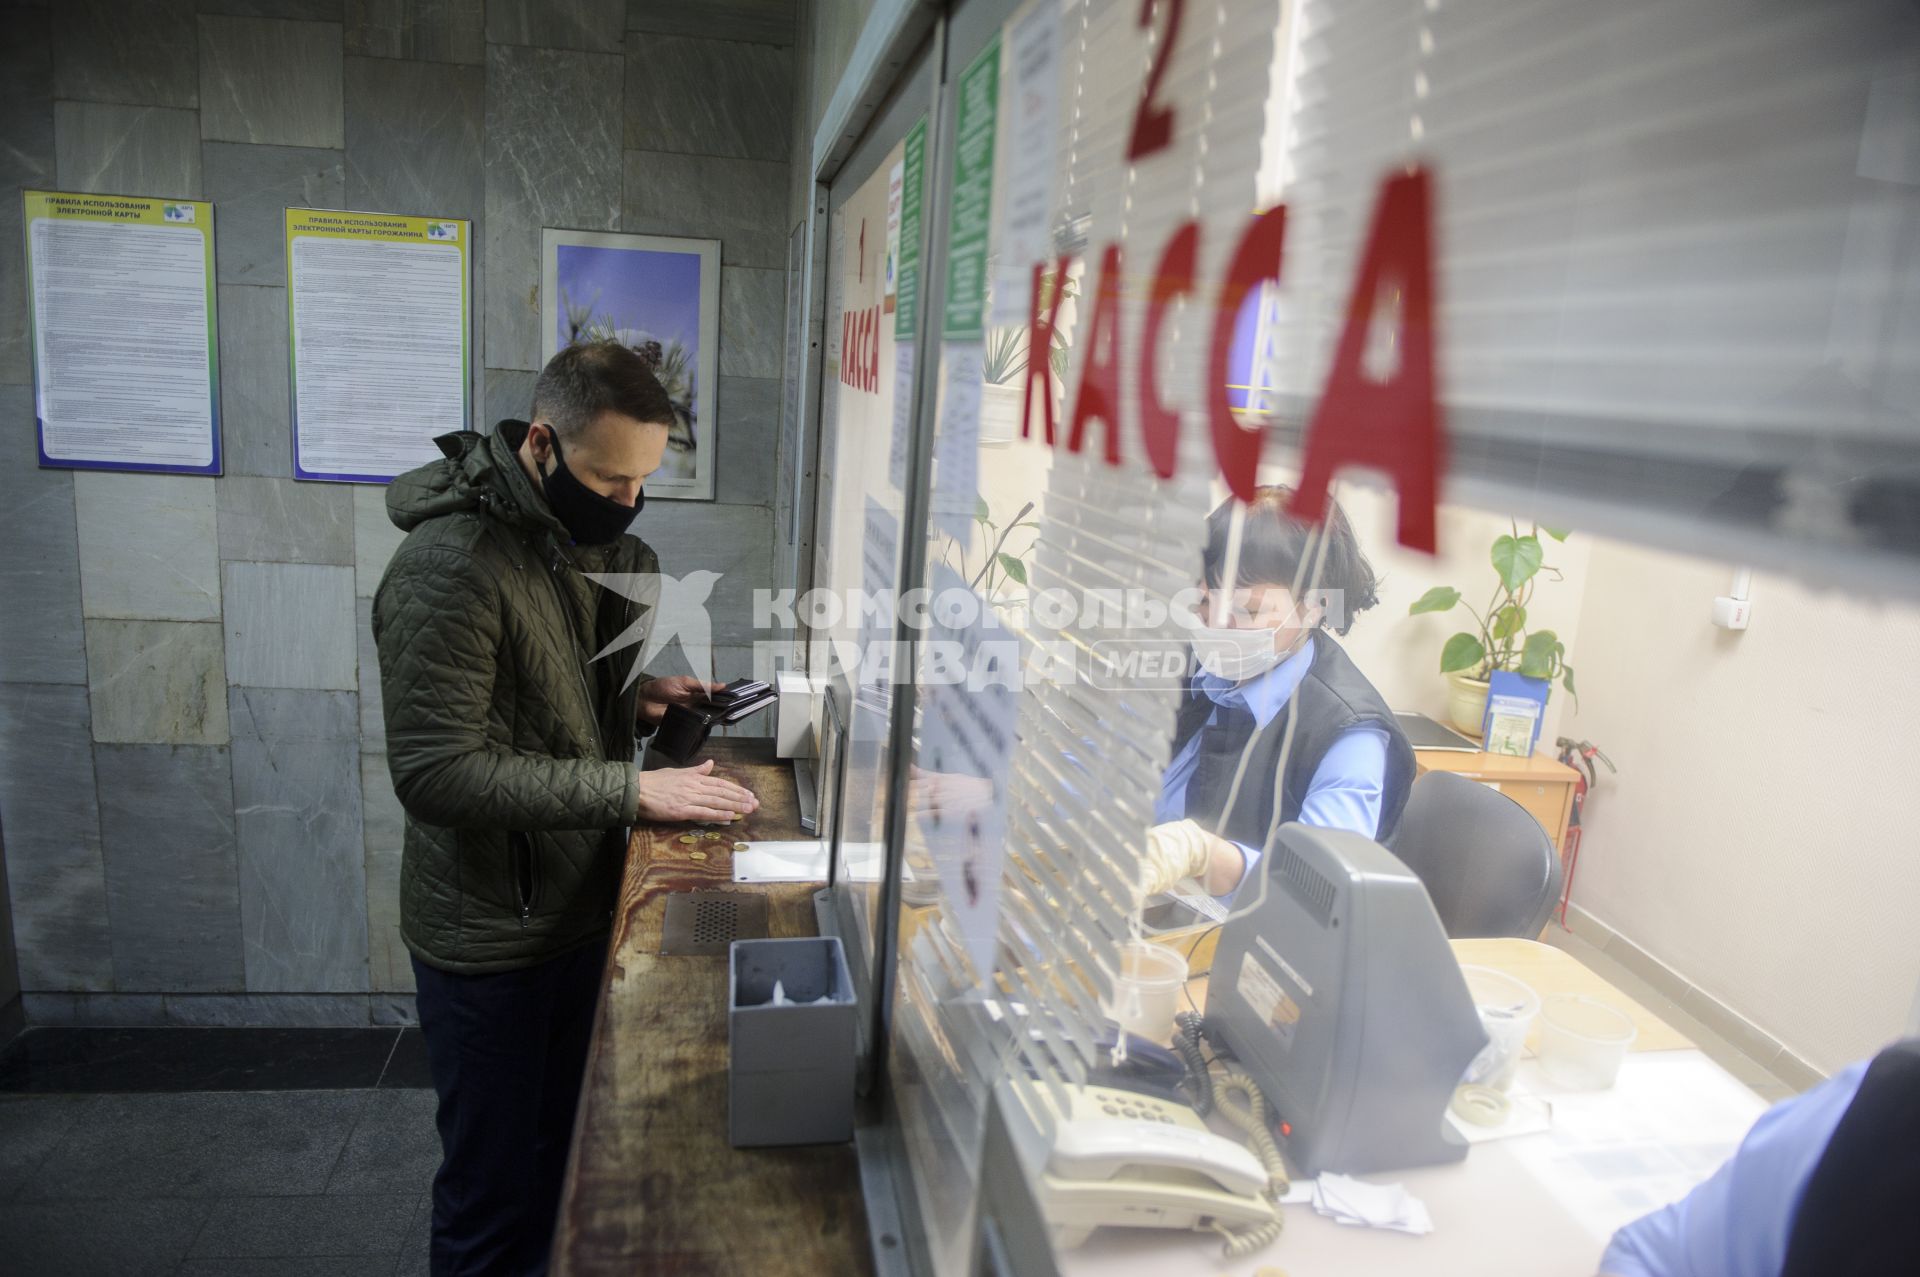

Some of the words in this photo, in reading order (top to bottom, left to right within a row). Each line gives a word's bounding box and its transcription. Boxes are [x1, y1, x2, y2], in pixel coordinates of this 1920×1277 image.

[1127, 0, 1179, 161] 2
[45, 197, 82, 206] ПРАВИЛА
[83, 199, 151, 211] ИСПОЛЬЗОВАНИЯ
[56, 206, 113, 217] ЭЛЕКТРОННОЙ
[114, 209, 141, 219] КАРТЫ
[308, 217, 343, 226] ПРАВИЛА
[344, 219, 408, 229] ИСПОЛЬЗОВАНИЯ
[292, 224, 347, 235] ЭЛЕКТРОННОЙ
[347, 228, 372, 236] КАРТЫ
[373, 229, 424, 239] ГОРОЖАНИНА
[841, 304, 880, 395] КАССА
[1022, 158, 1440, 560] КАССА
